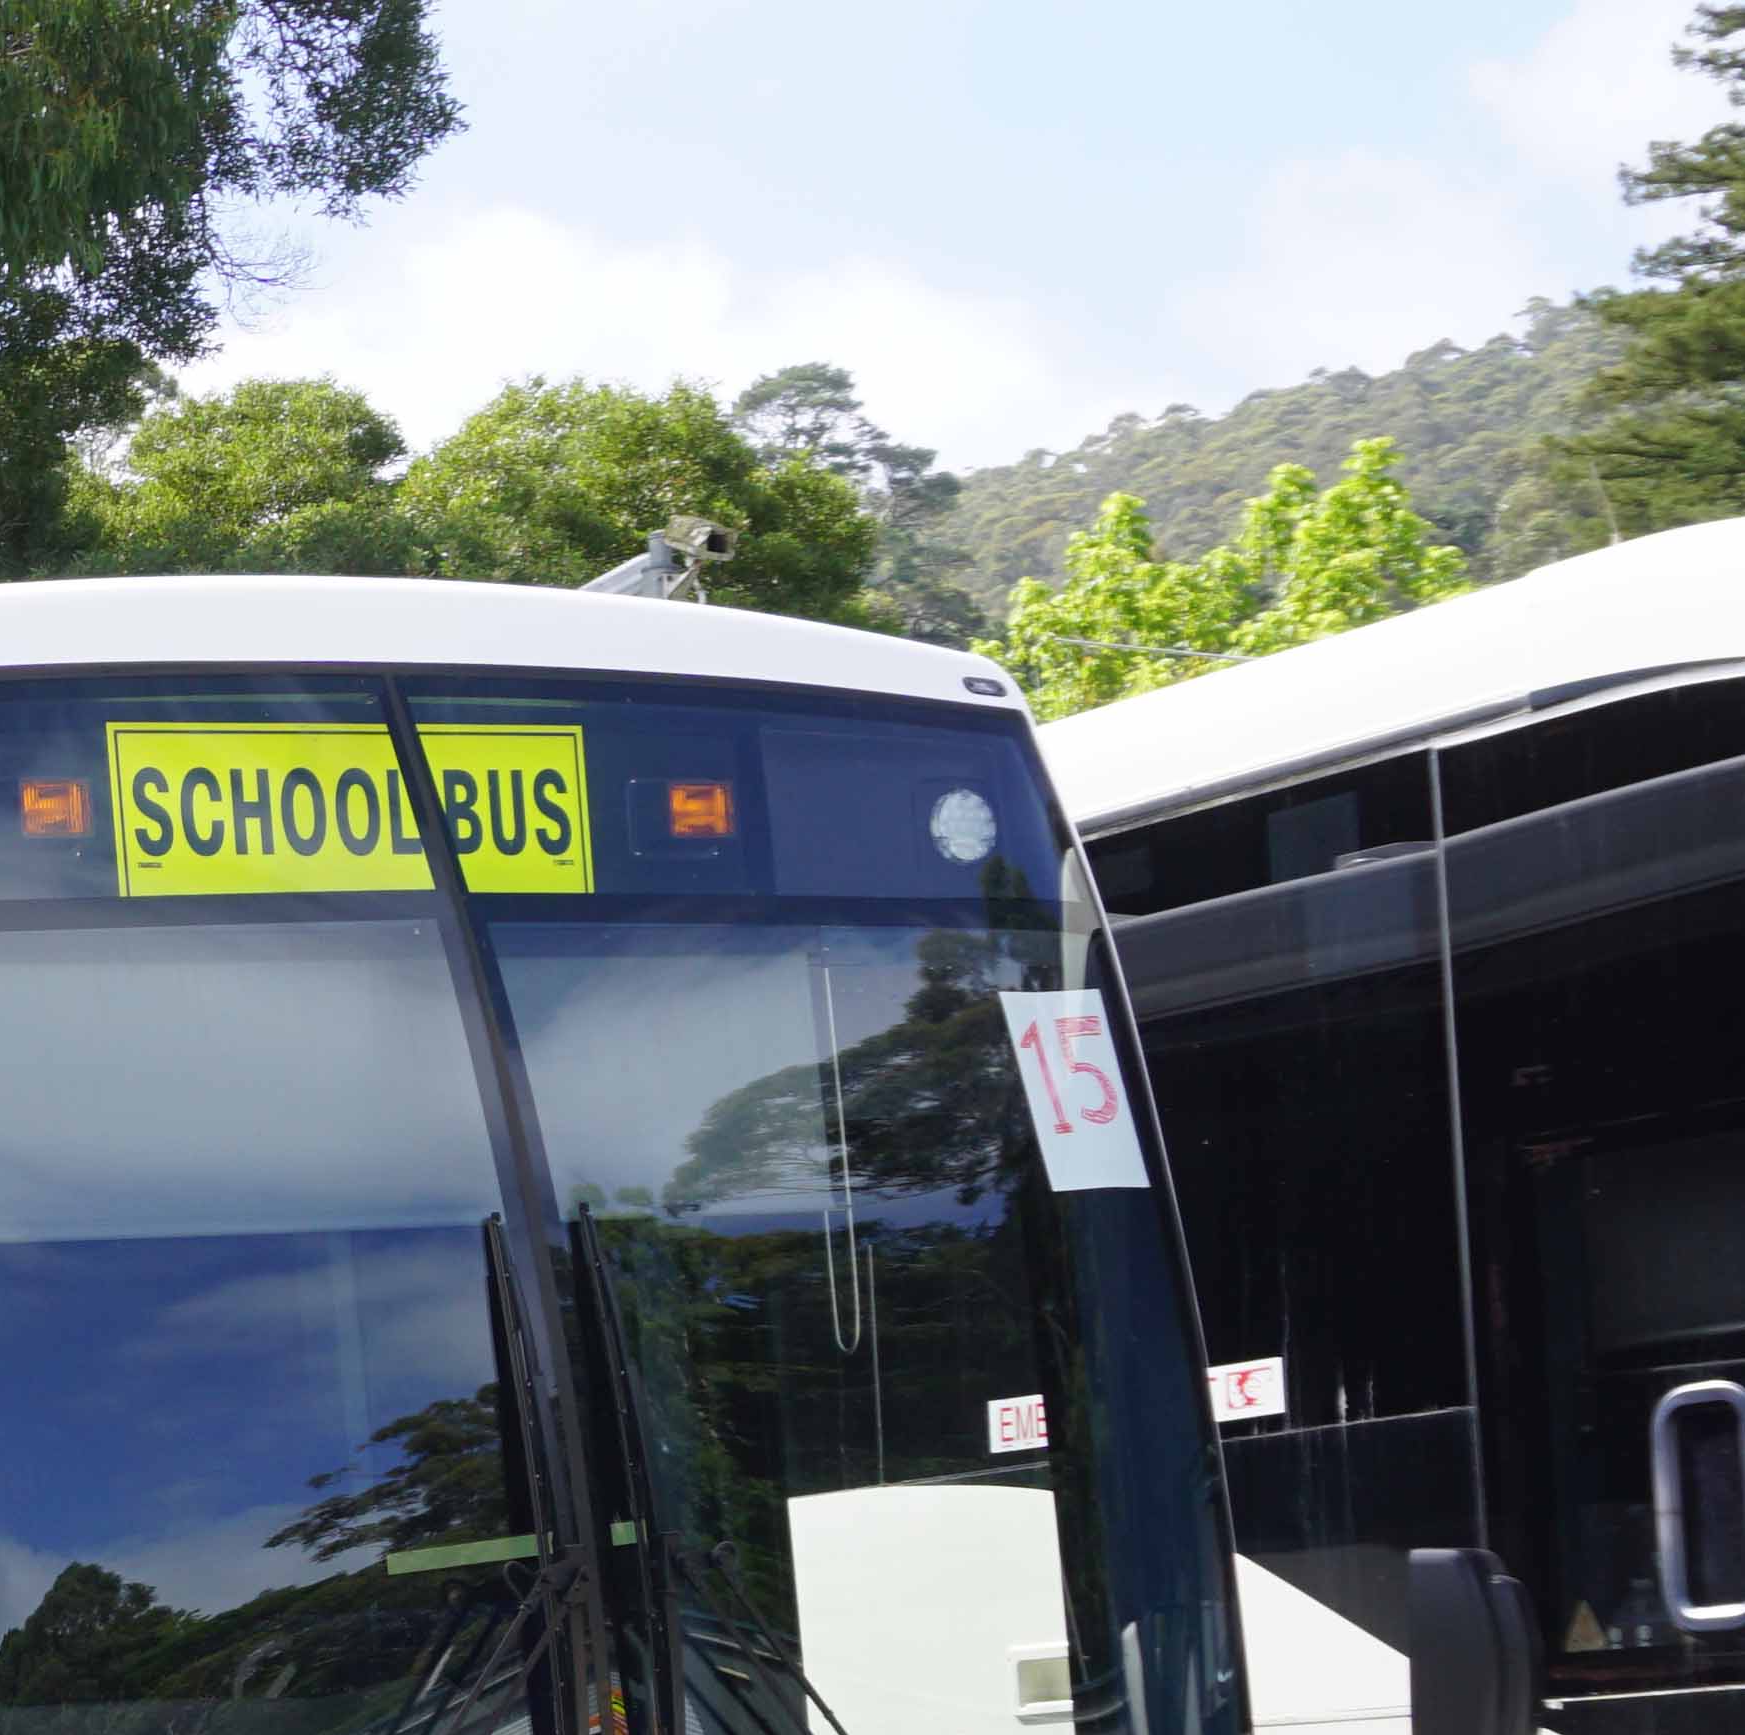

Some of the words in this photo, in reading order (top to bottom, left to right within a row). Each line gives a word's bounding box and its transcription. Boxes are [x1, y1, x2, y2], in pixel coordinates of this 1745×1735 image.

[132, 766, 423, 857] SCHOOL
[443, 768, 573, 857] BUS
[1020, 1015, 1118, 1133] 15
